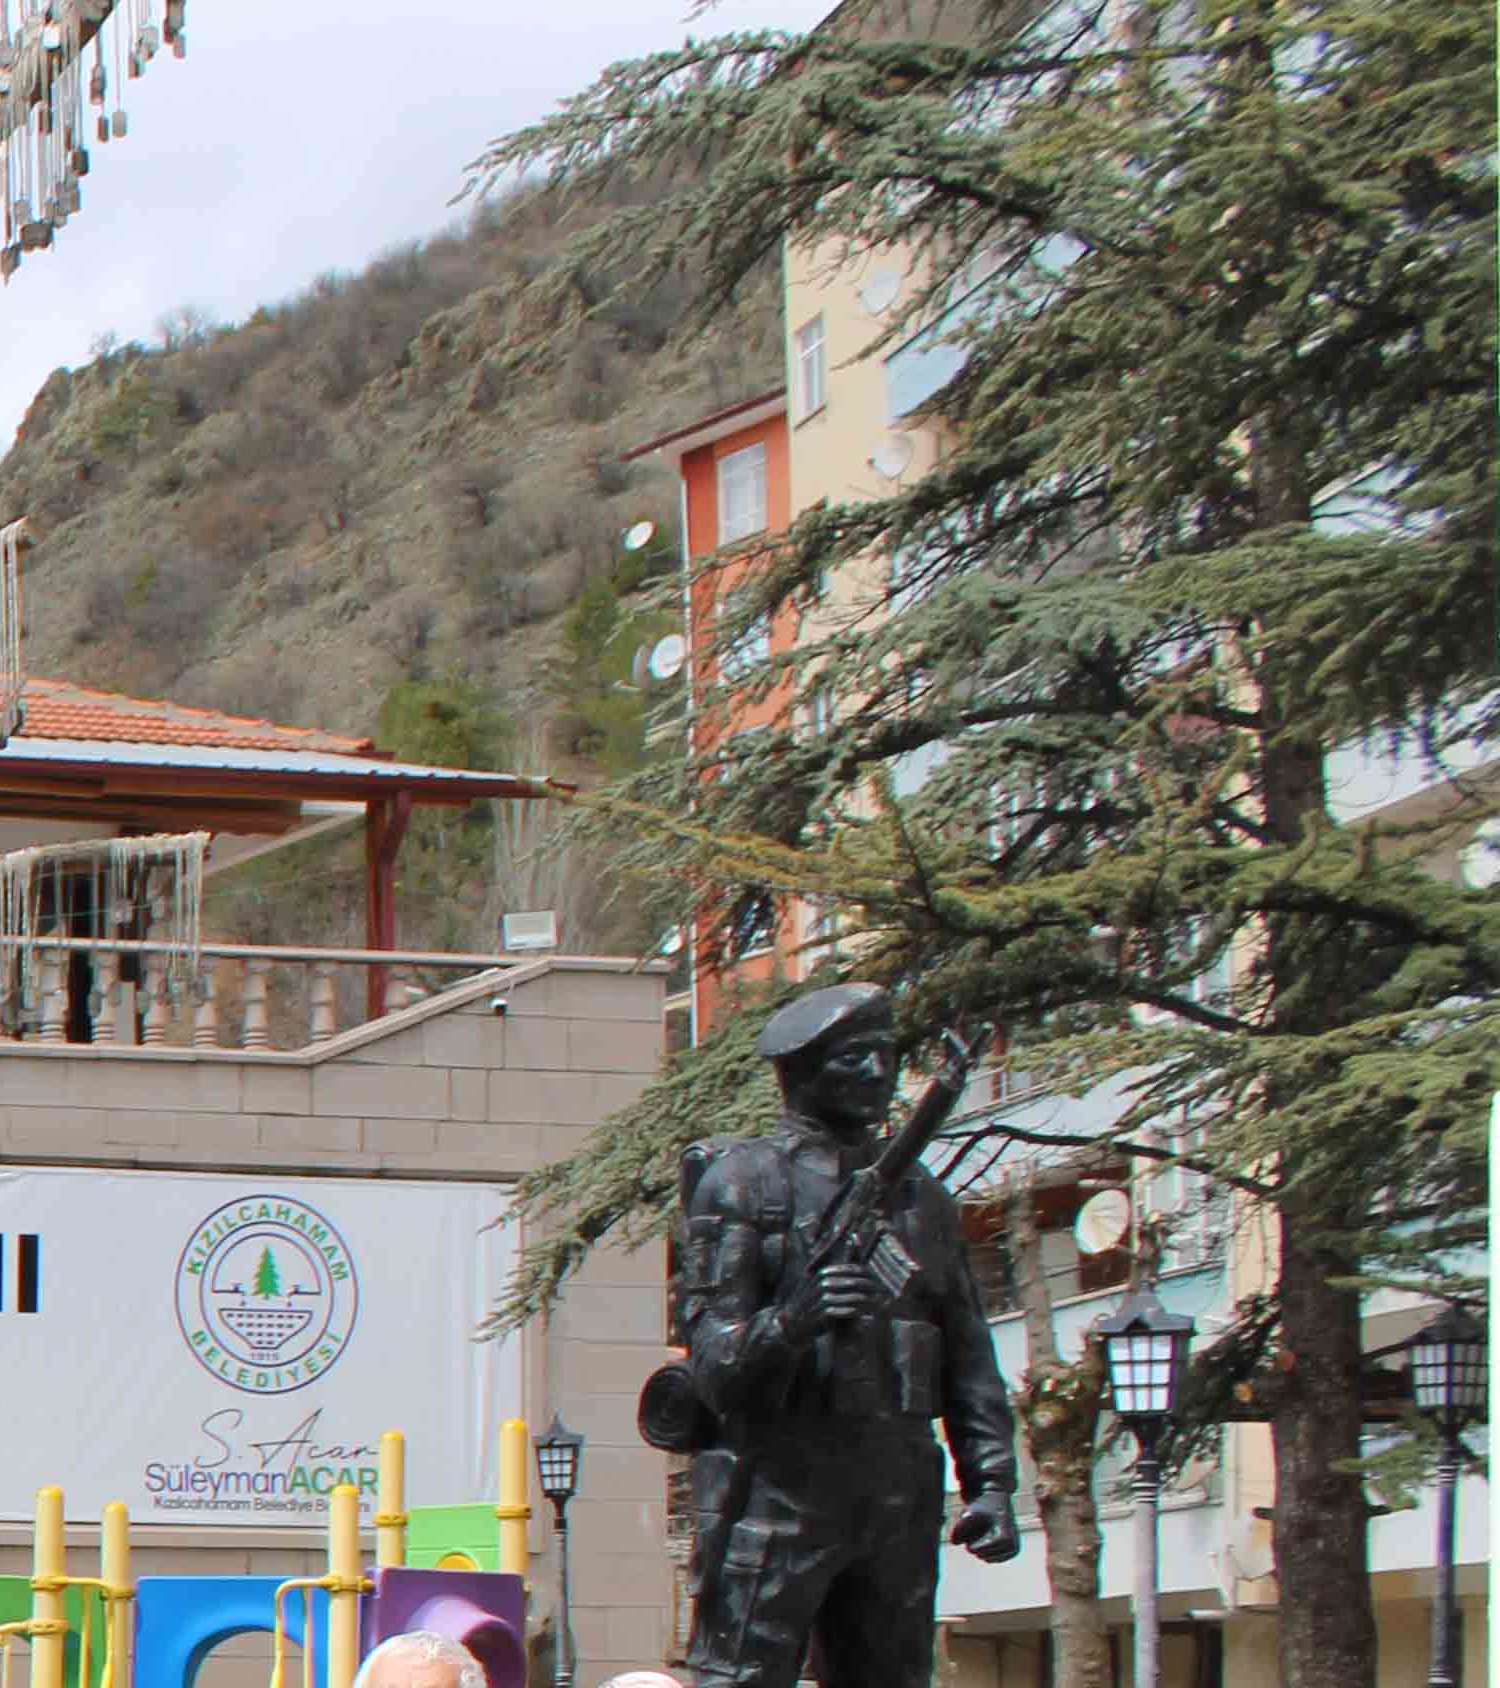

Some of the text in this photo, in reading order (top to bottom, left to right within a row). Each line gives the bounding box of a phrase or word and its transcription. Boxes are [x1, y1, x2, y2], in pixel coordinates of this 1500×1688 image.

[185, 1202, 350, 1283] KIZILCAHAMAM
[187, 1330, 343, 1390] BELEDİYESİ
[253, 1497, 313, 1512] Belediye
